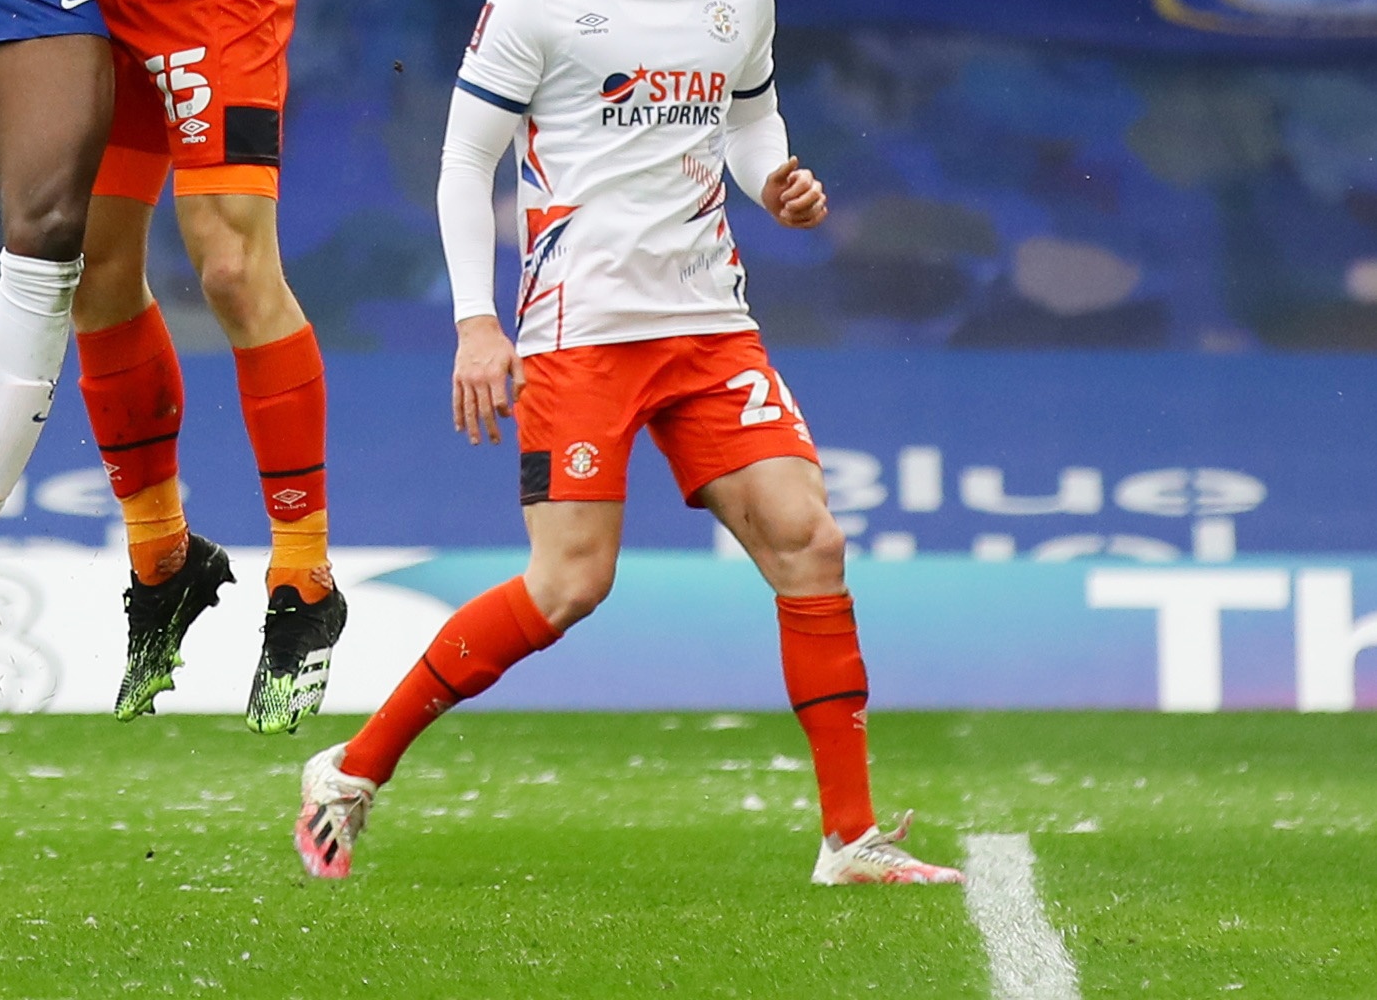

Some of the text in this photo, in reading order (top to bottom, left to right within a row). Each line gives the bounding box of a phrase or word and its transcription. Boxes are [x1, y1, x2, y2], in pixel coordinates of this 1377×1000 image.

[144, 46, 212, 123] 15
[649, 71, 726, 103] STAR
[602, 105, 721, 127] PLATFORMS
